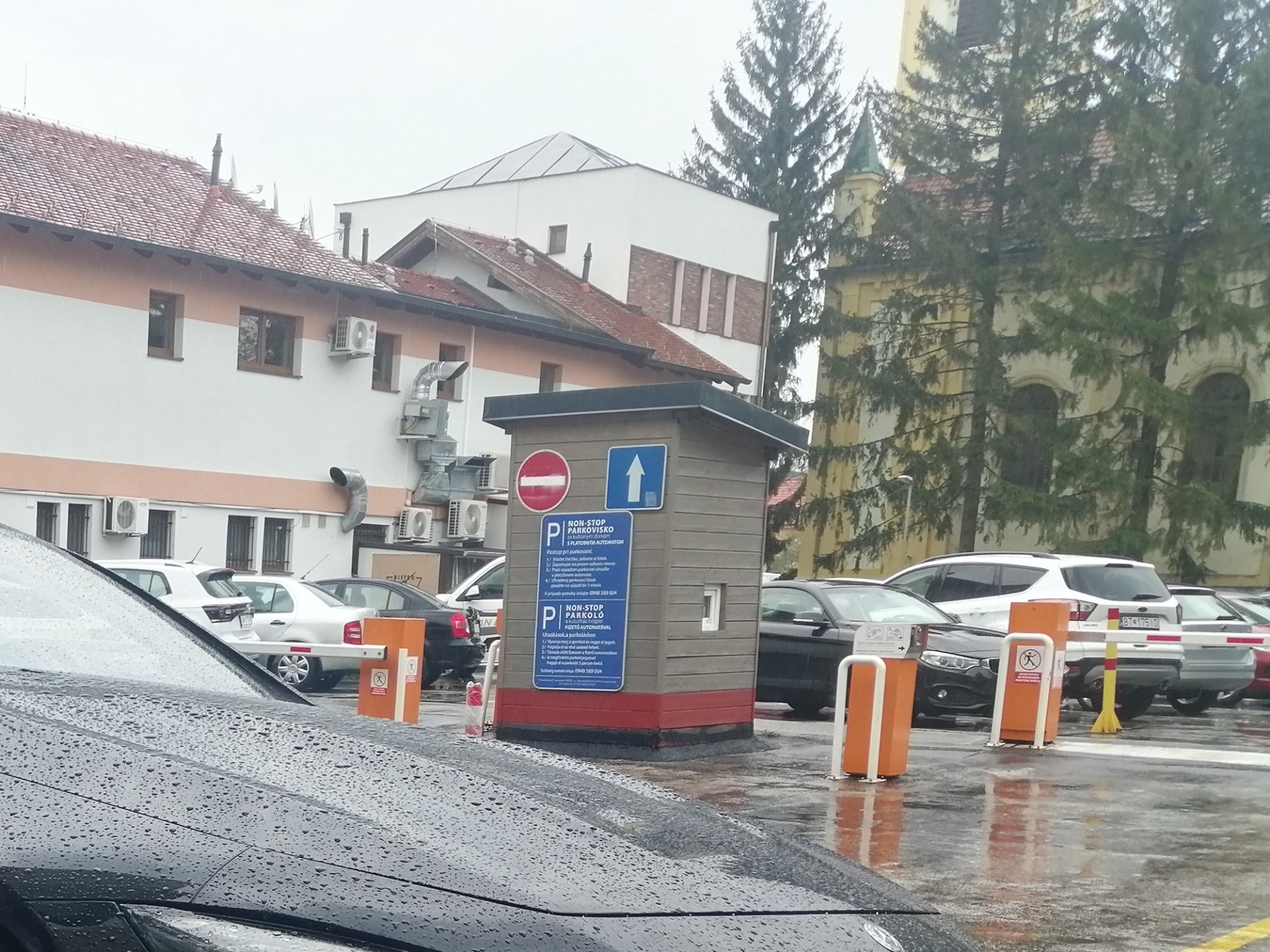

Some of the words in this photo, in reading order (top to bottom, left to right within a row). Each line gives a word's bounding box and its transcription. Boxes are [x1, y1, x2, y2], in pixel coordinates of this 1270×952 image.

[567, 526, 614, 534] PARKOVISKO
[568, 519, 606, 527] NON-STOP
[546, 522, 560, 546] P
[542, 606, 556, 630] P
